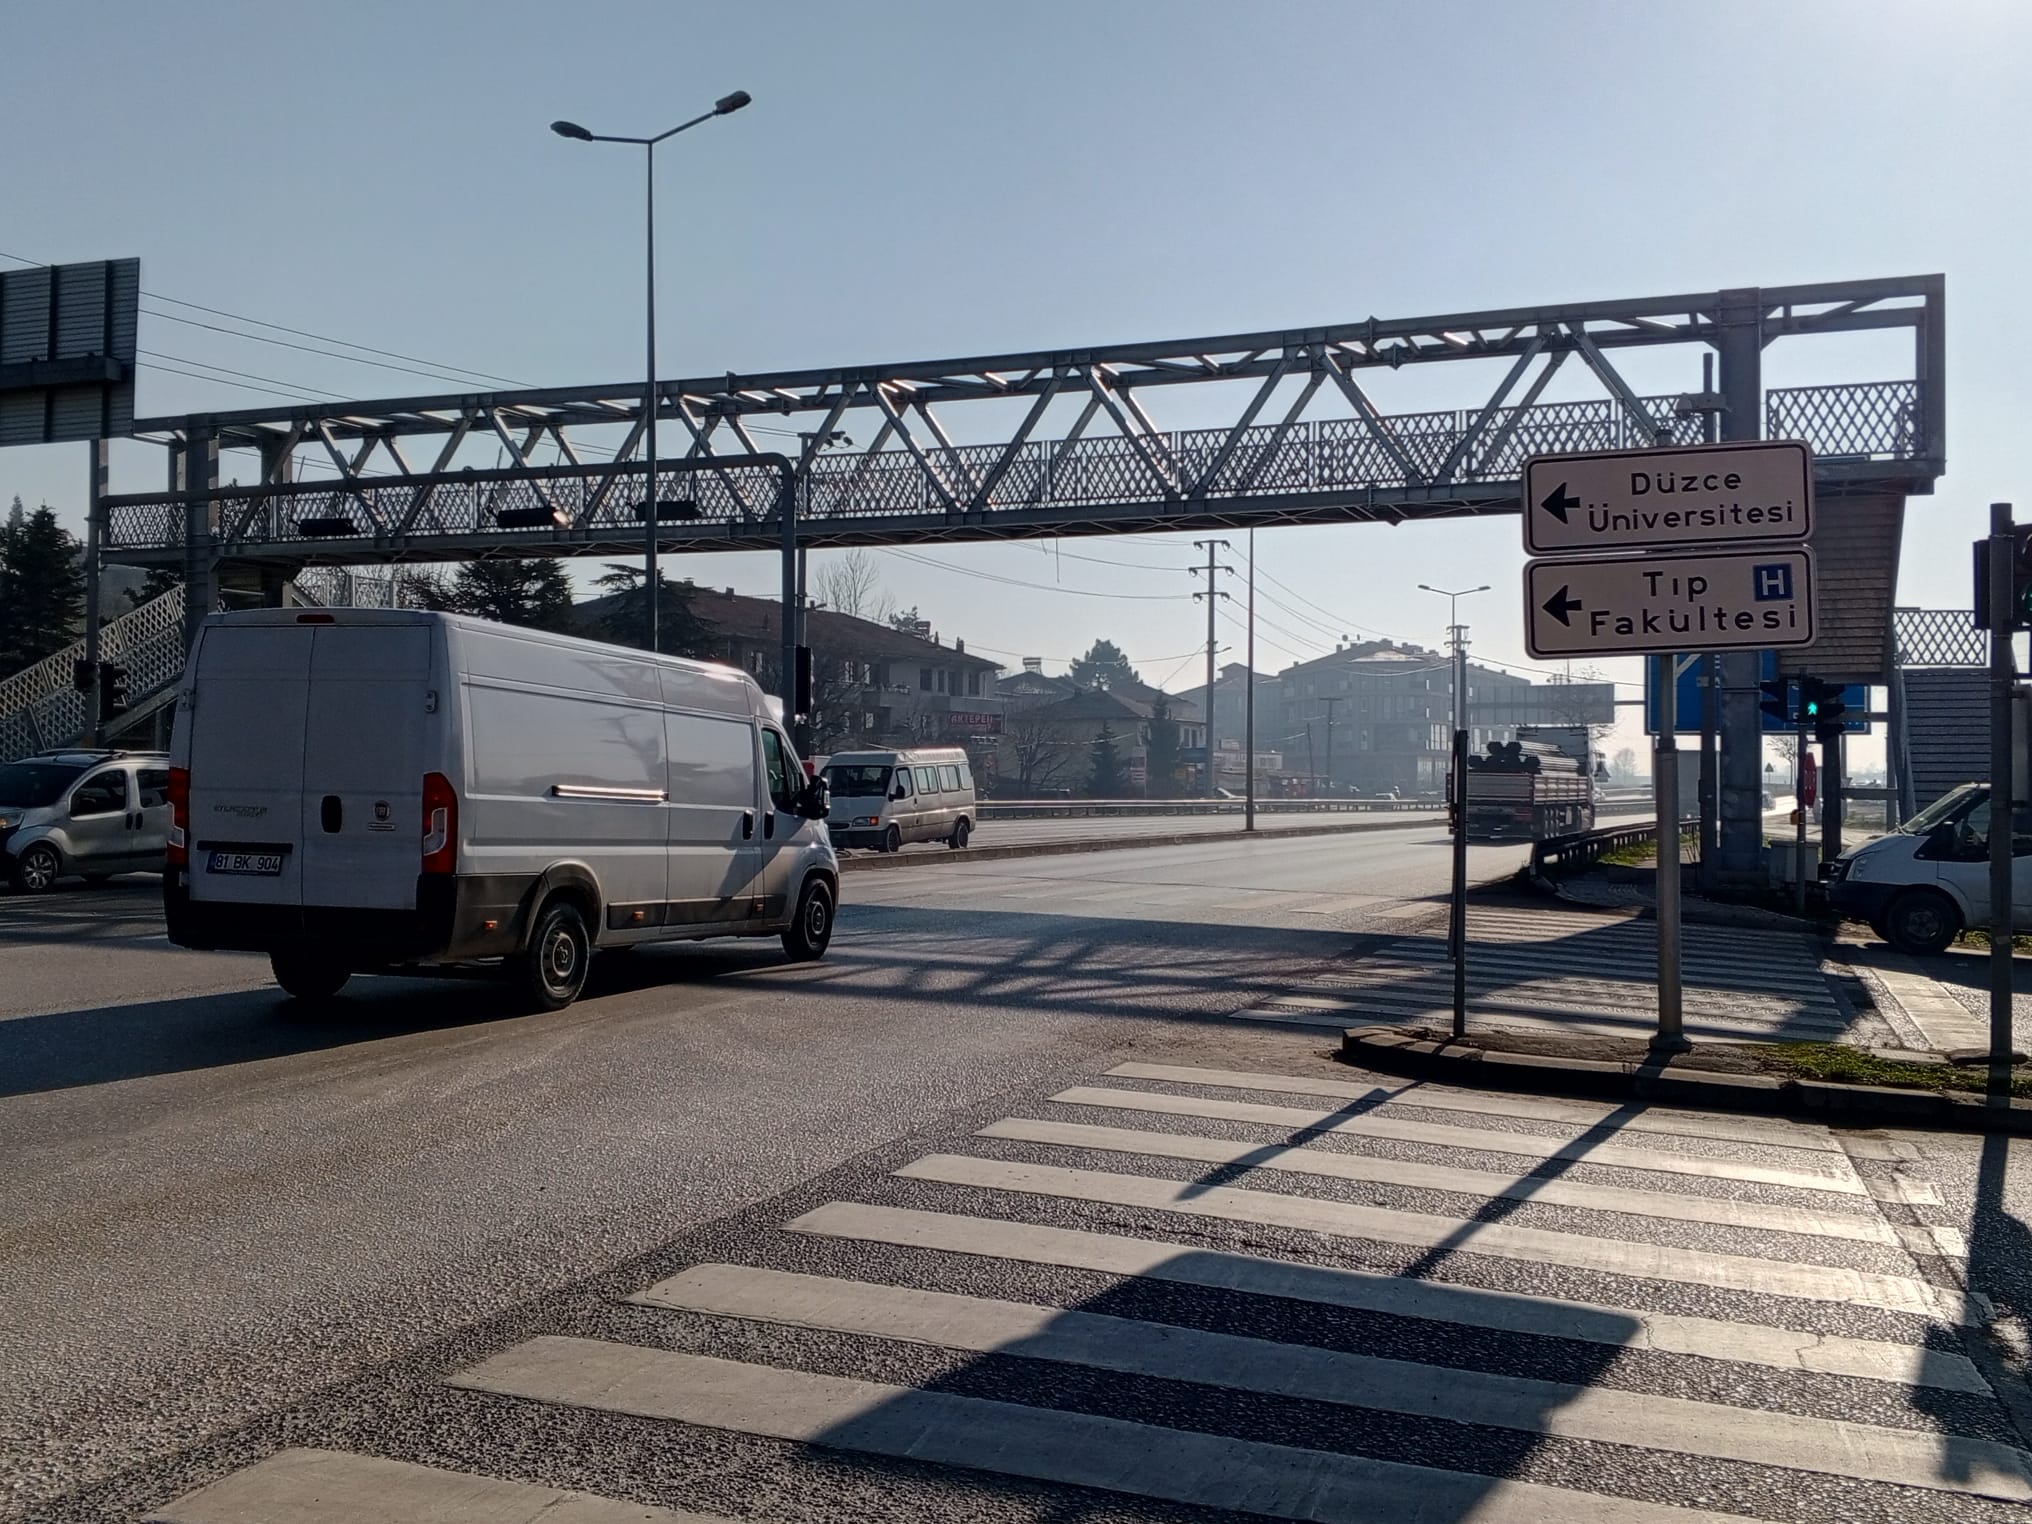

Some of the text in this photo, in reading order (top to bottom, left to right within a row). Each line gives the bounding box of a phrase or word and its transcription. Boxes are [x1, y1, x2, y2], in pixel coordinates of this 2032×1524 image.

[1631, 472, 1742, 496] Düzce
[1588, 501, 1793, 532] Üniversitesi
[1643, 571, 1708, 602] Tıp
[1761, 569, 1785, 596] H
[216, 855, 279, 871] 81 BK 904
